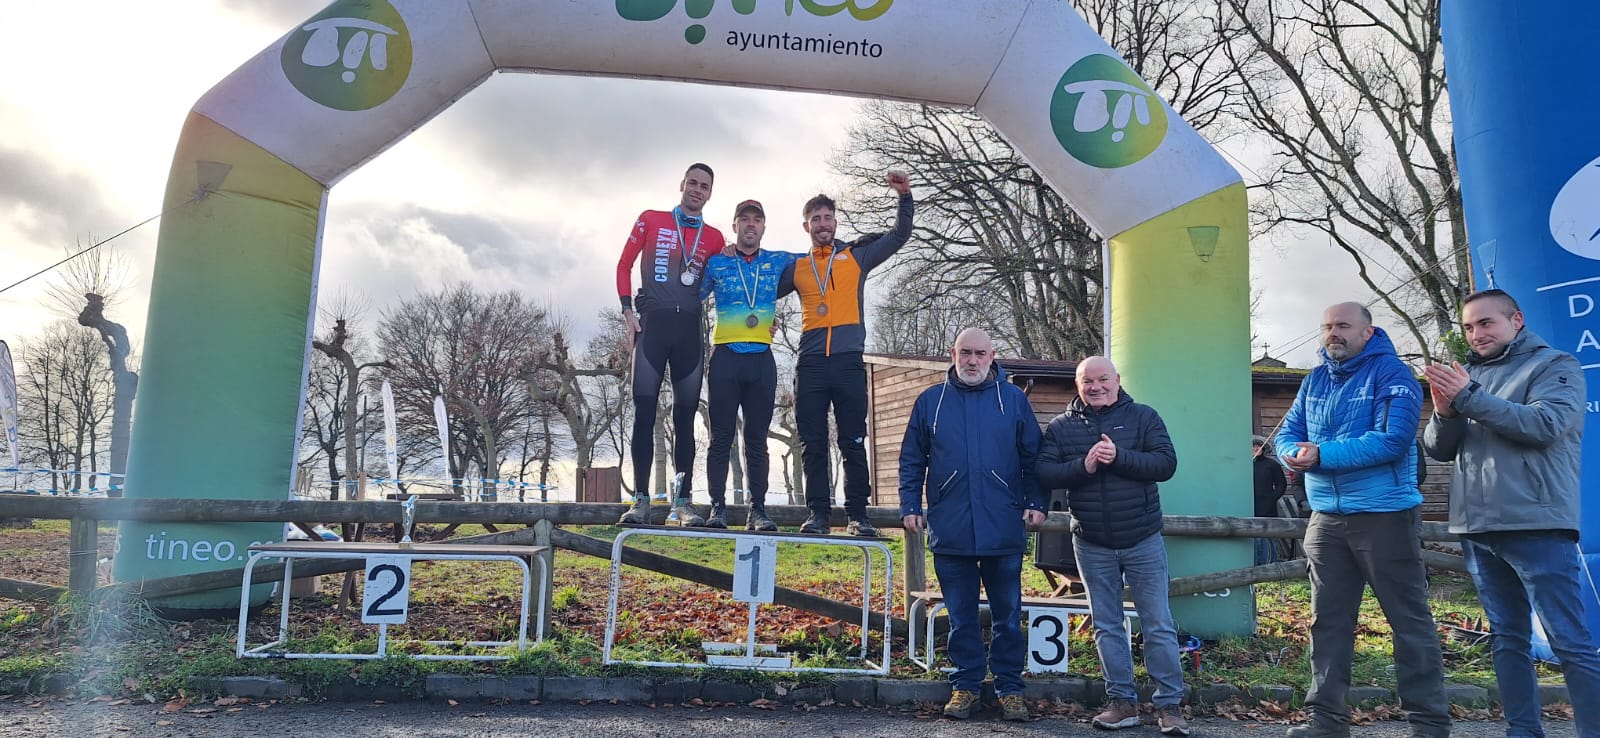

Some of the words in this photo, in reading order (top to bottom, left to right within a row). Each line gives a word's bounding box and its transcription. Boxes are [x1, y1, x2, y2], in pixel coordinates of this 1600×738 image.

[726, 30, 883, 58] ayuntamiento
[654, 227, 673, 282] CORNEYU
[366, 564, 405, 616] 2
[739, 546, 760, 597] 1
[1031, 615, 1065, 665] 3
